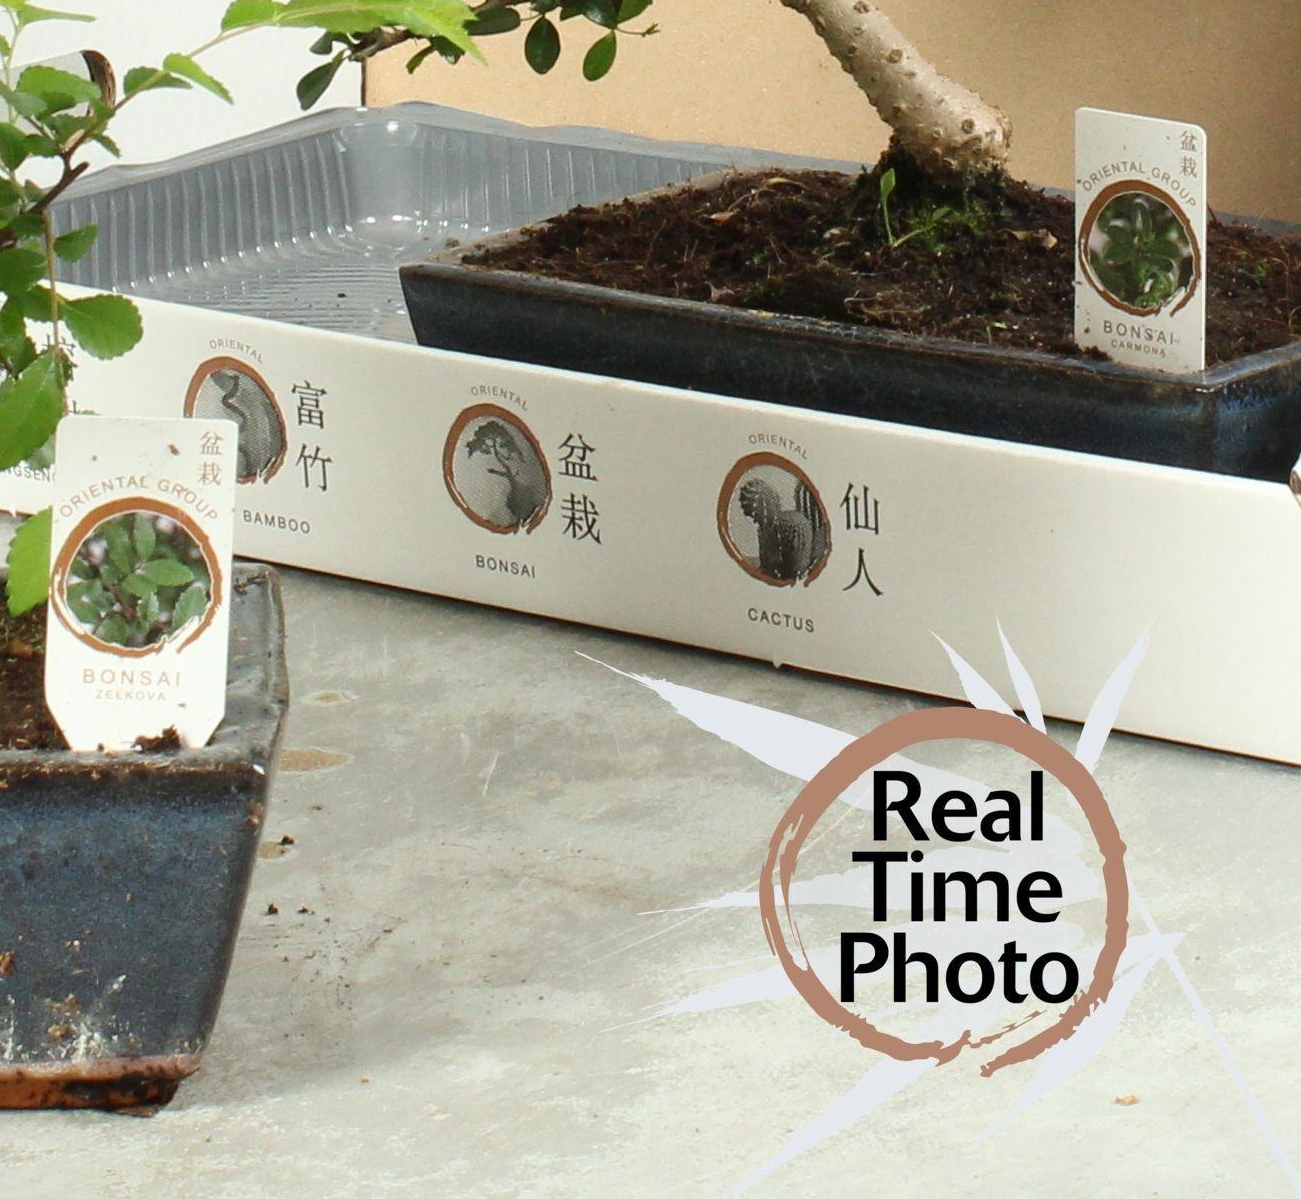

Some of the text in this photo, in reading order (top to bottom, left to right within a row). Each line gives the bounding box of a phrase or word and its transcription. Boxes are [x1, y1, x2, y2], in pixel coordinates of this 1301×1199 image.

[1180, 130, 1197, 178] 盆栽
[1082, 161, 1196, 206] ORIENTAL GROUP
[1103, 320, 1173, 345] BONSAI
[209, 339, 264, 364] ORIENTAL
[1111, 339, 1166, 358] CARMONA
[471, 385, 529, 411] ORIENTAL
[291, 380, 333, 492] 富竹
[748, 434, 809, 460] ORIENTAL
[198, 431, 223, 486] 盆栽
[60, 476, 218, 521] ORIENTAL GROUP
[558, 433, 602, 545] 盆栽
[243, 509, 310, 534] BAMBOO
[840, 482, 883, 596] 仙人
[476, 555, 536, 578] BONSAI
[747, 607, 815, 633] CACTUS
[83, 668, 181, 687] BONSAI
[95, 688, 166, 702] ZELKOVA
